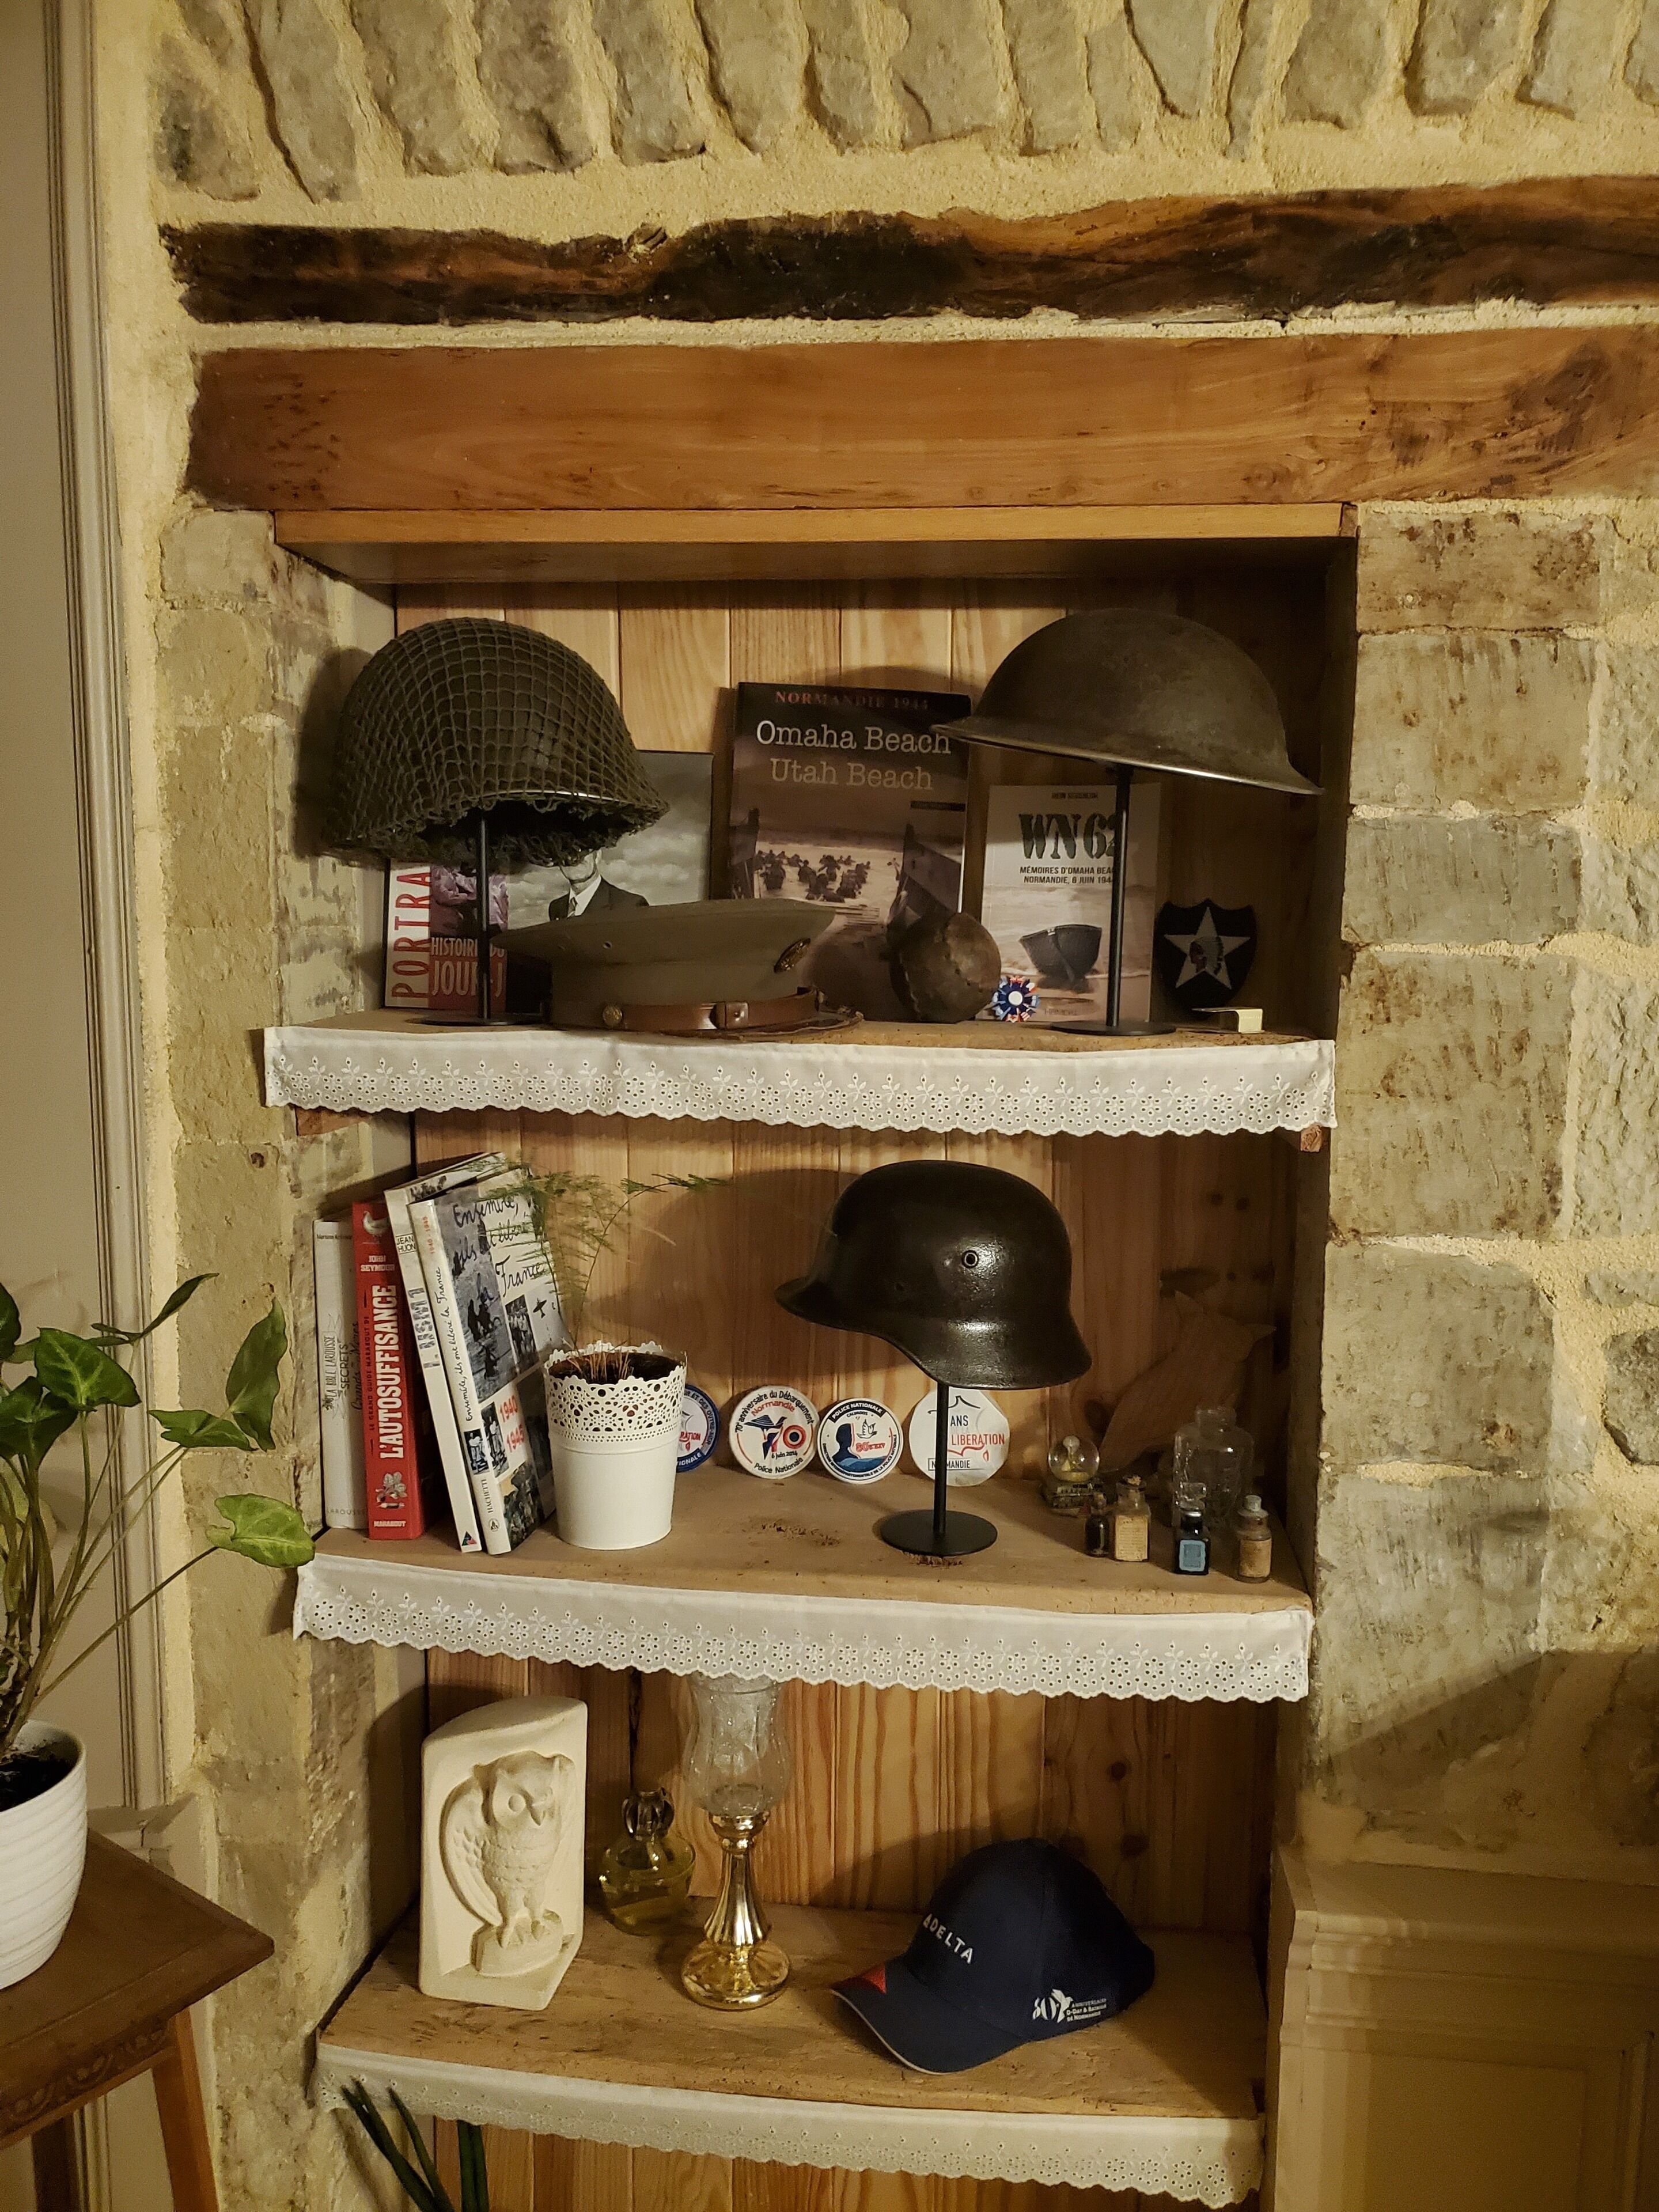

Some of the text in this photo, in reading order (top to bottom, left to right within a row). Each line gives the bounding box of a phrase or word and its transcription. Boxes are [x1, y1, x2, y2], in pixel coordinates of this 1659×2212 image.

[756, 719, 952, 755] Omaha Beach
[770, 757, 933, 791] Utah Beach
[1020, 865, 1113, 875] MÉMOIRES D'OMAHA BEA
[1024, 876, 1070, 885] NORMANDIE,
[1071, 876, 1077, 884] 6
[1079, 876, 1094, 884] JUIN
[391, 872, 432, 998] PORTRA
[431, 936, 478, 957] HISTOIR
[396, 1236, 414, 1245] JEAN
[434, 1266, 448, 1304] France
[440, 1306, 450, 1318] la
[323, 1335, 336, 1370] LAROUSSE
[453, 1346, 461, 1361] ont
[339, 1344, 350, 1390] SECRETS
[372, 1285, 404, 1459] L'AUTOSUFFISANCE
[499, 1395, 518, 1423] 1940
[738, 1393, 768, 1423] anniversaire
[770, 1390, 778, 1398] du
[778, 1391, 815, 1425] Débarquement
[751, 1400, 796, 1416] Normandie
[832, 1403, 882, 1419] POLICE NATIONALE
[950, 1415, 968, 1427] ANS
[680, 1431, 701, 1441] RATION
[952, 1433, 1005, 1446] LIBERATION
[754, 1457, 804, 1474] Police Nationale
[882, 1455, 893, 1468] POLICE
[931, 1460, 971, 1469] NMANDIE
[929, 1917, 974, 1964] DELTA
